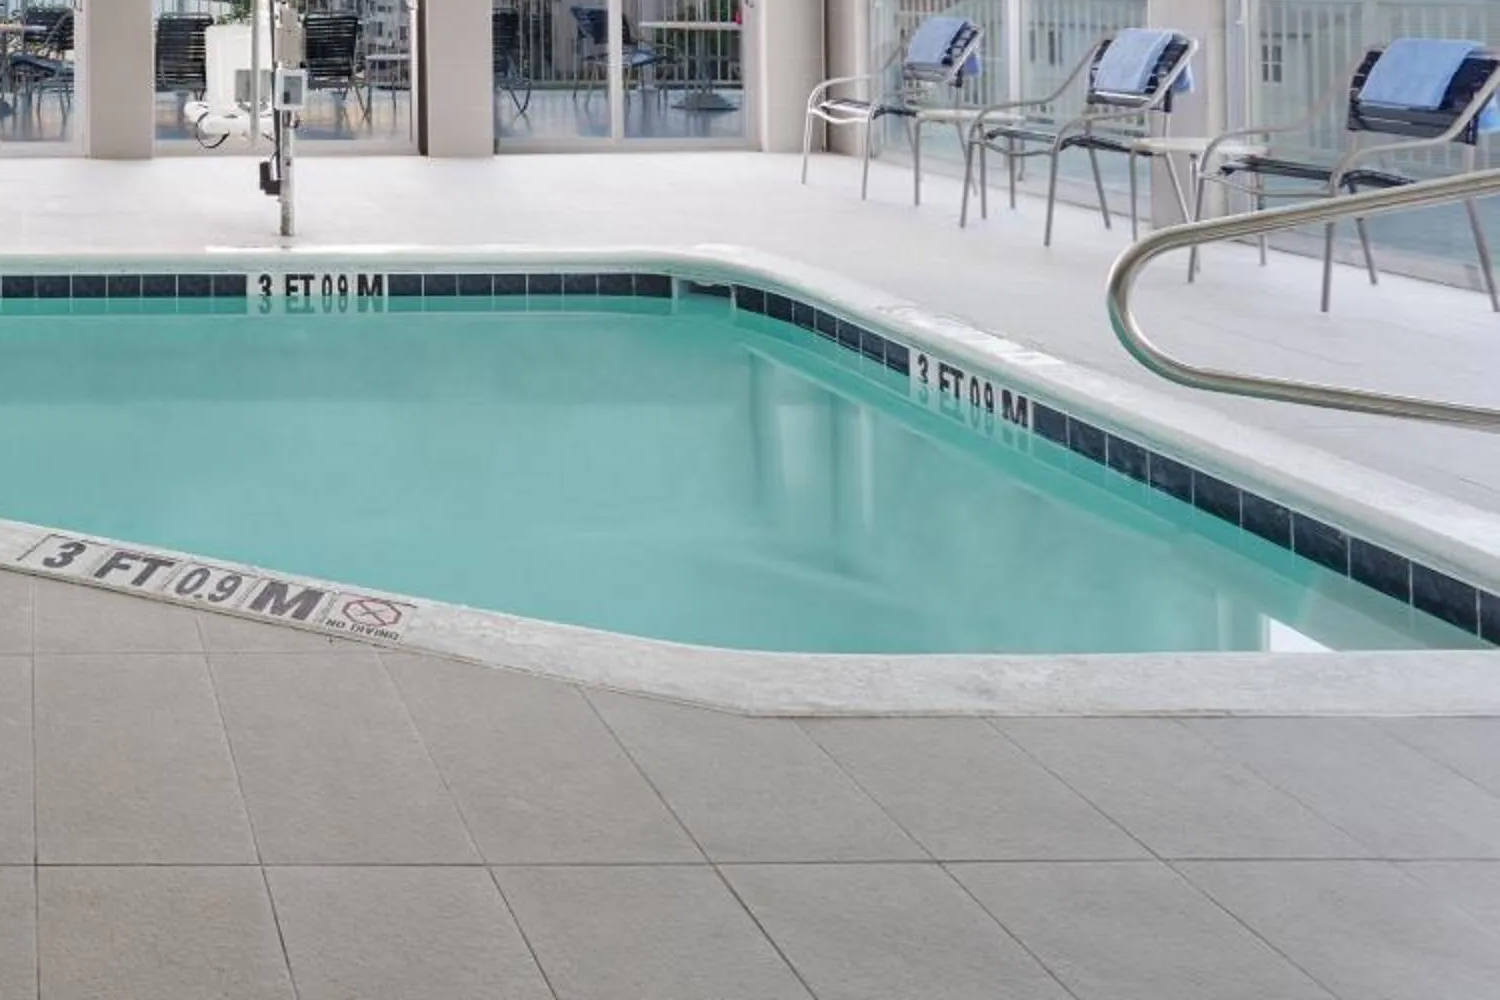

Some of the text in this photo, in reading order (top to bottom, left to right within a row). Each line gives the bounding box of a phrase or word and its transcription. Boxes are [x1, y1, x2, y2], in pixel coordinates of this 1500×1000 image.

[258, 274, 272, 297] 3
[285, 274, 315, 297] FT
[356, 274, 383, 297] M
[918, 353, 929, 385] 3
[939, 362, 964, 400] FT
[1002, 389, 1029, 429] M
[43, 541, 326, 621] 3 FT 0.9 M
[325, 619, 400, 641] NO DIVING
